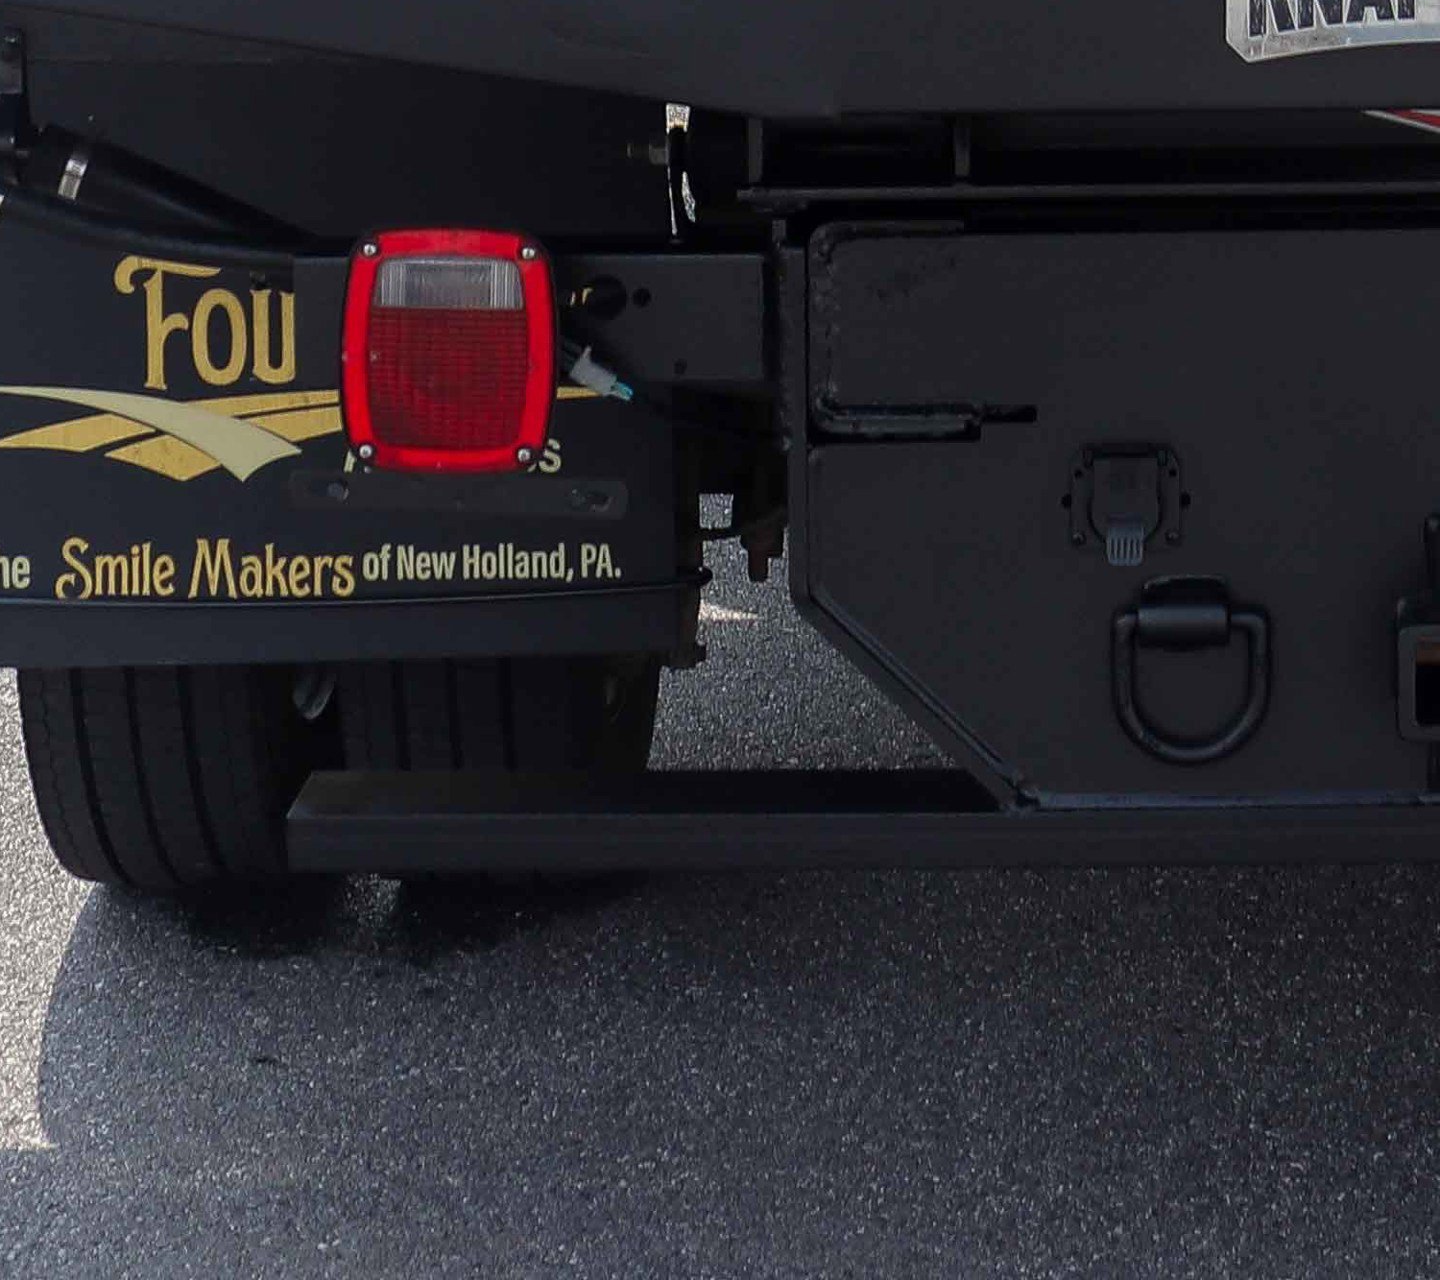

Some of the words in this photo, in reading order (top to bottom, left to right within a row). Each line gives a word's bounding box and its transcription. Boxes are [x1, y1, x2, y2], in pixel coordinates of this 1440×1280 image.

[114, 255, 296, 390] FOU
[54, 537, 176, 600] Smile
[188, 538, 356, 600] Makers
[362, 543, 392, 581] of
[396, 543, 457, 581] New
[462, 542, 574, 582] Holland,
[580, 543, 623, 579] PA.
